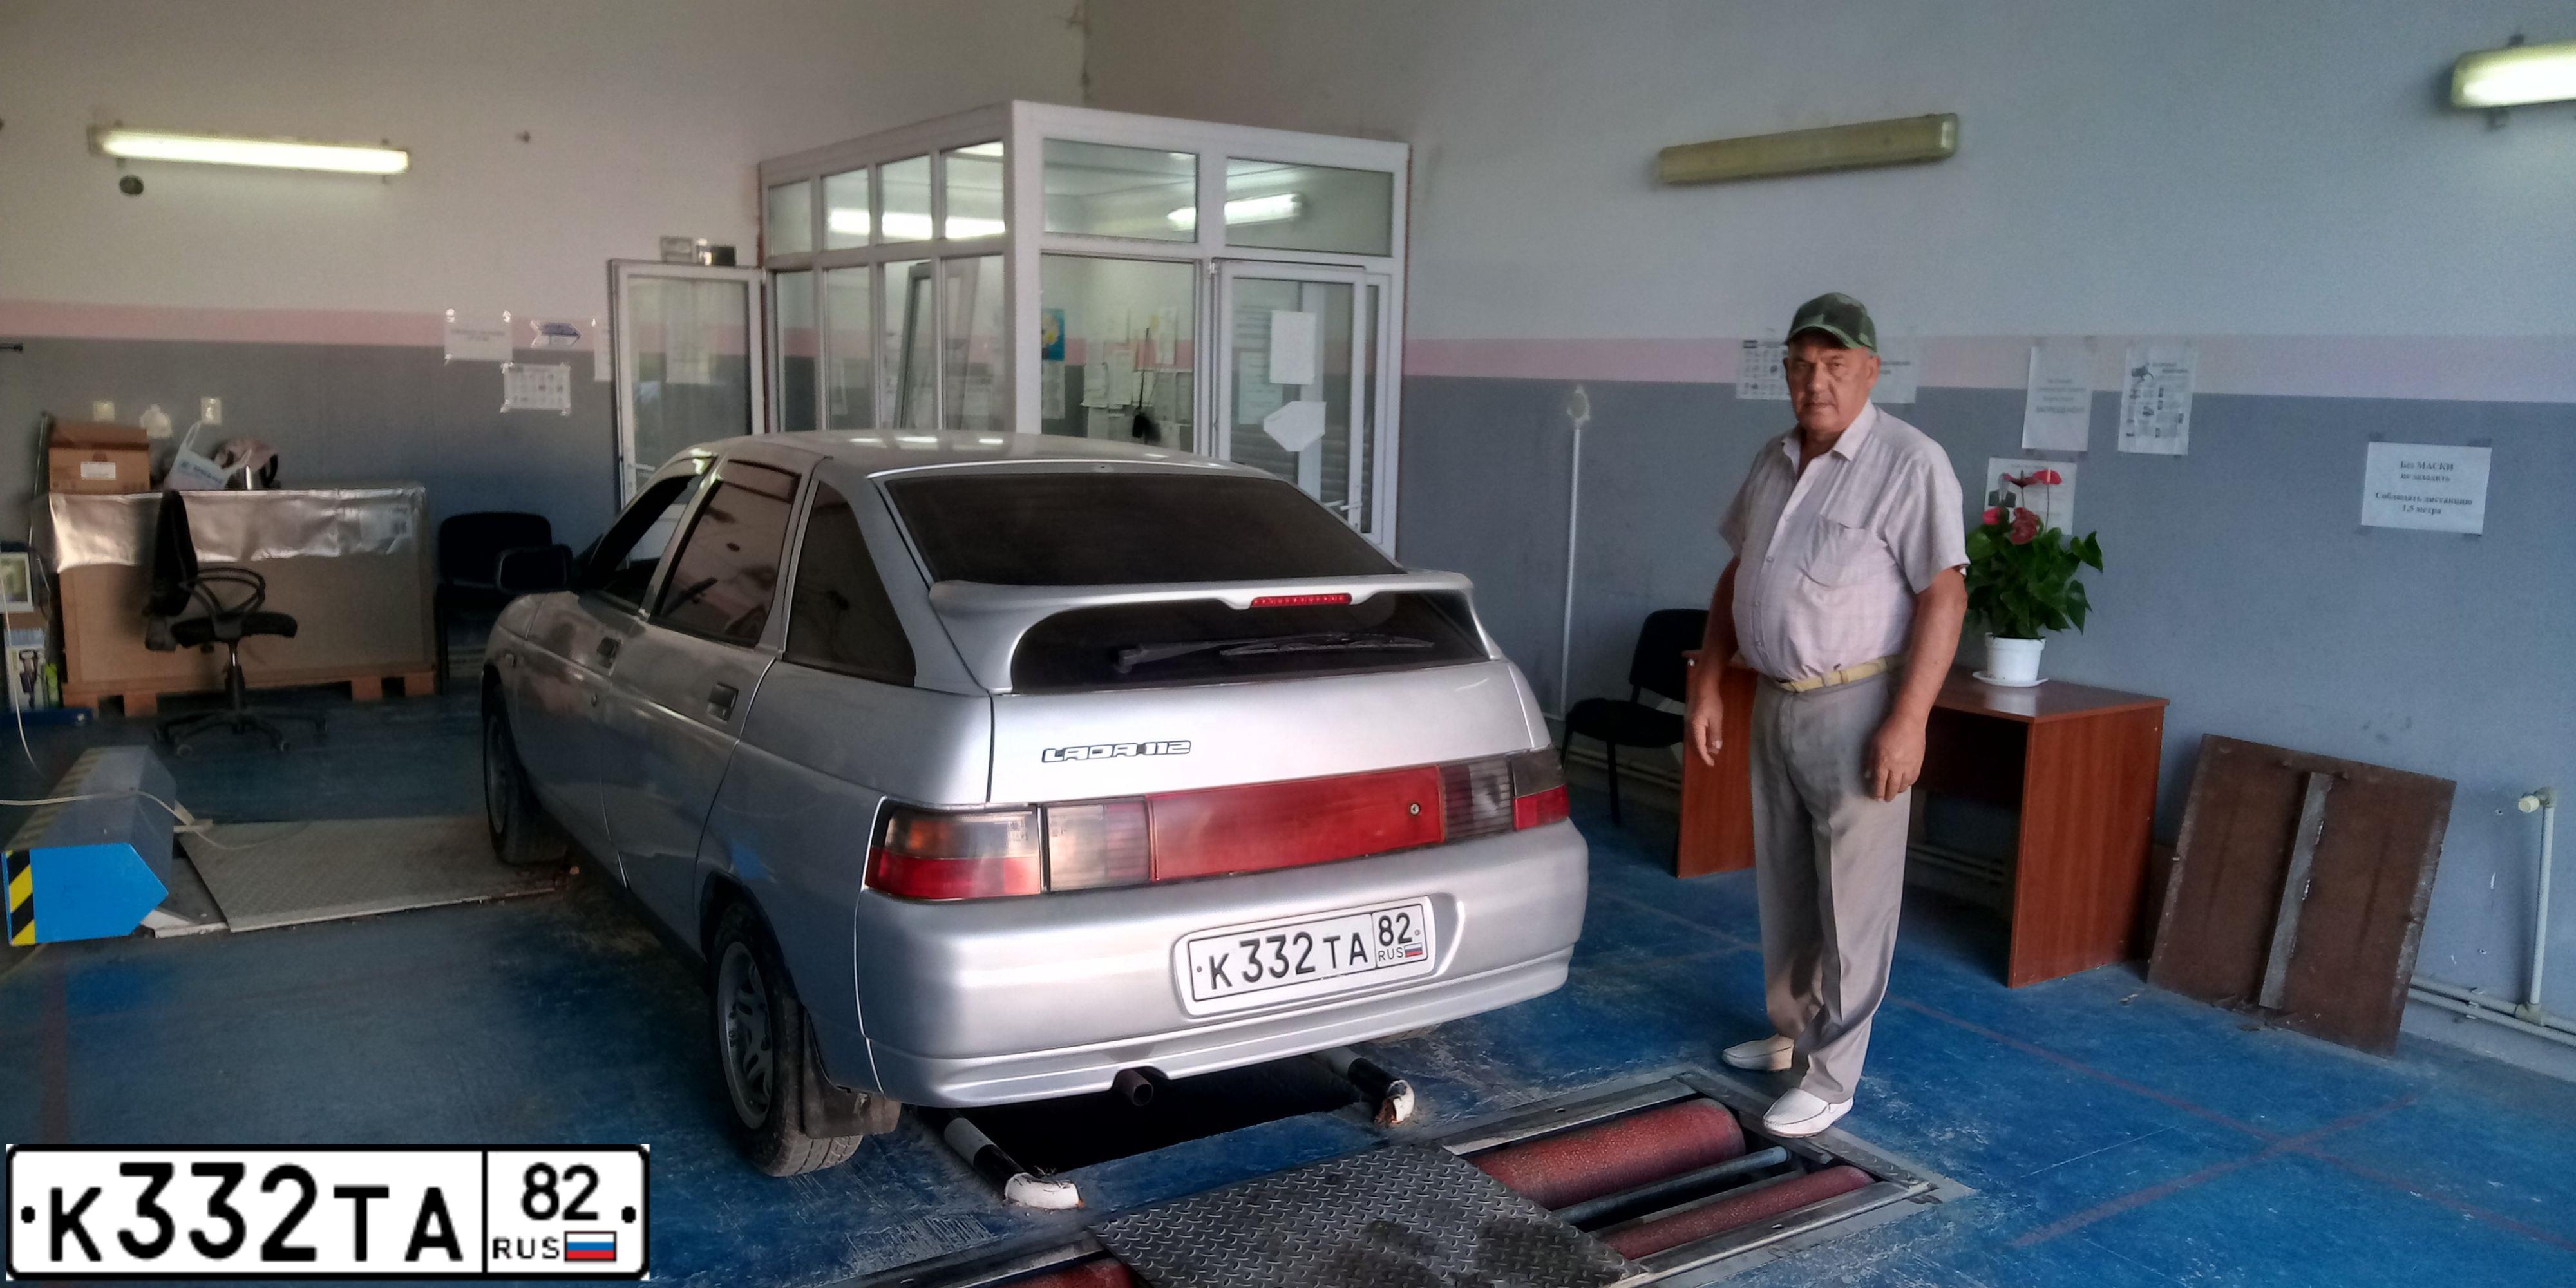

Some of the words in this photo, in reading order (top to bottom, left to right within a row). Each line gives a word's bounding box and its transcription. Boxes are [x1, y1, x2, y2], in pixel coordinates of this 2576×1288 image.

[2400, 460, 2415, 469] Без
[2416, 460, 2454, 471] МАСКИ
[2375, 491, 2422, 502] Соблюдать
[2423, 495, 2473, 506] дистанцию
[2401, 504, 2415, 513] 1,5
[2416, 506, 2442, 516] метра
[1041, 743, 1138, 763] LADA
[1143, 740, 1191, 755] 112
[1378, 912, 1413, 947] 82
[1378, 947, 1404, 963] RUS
